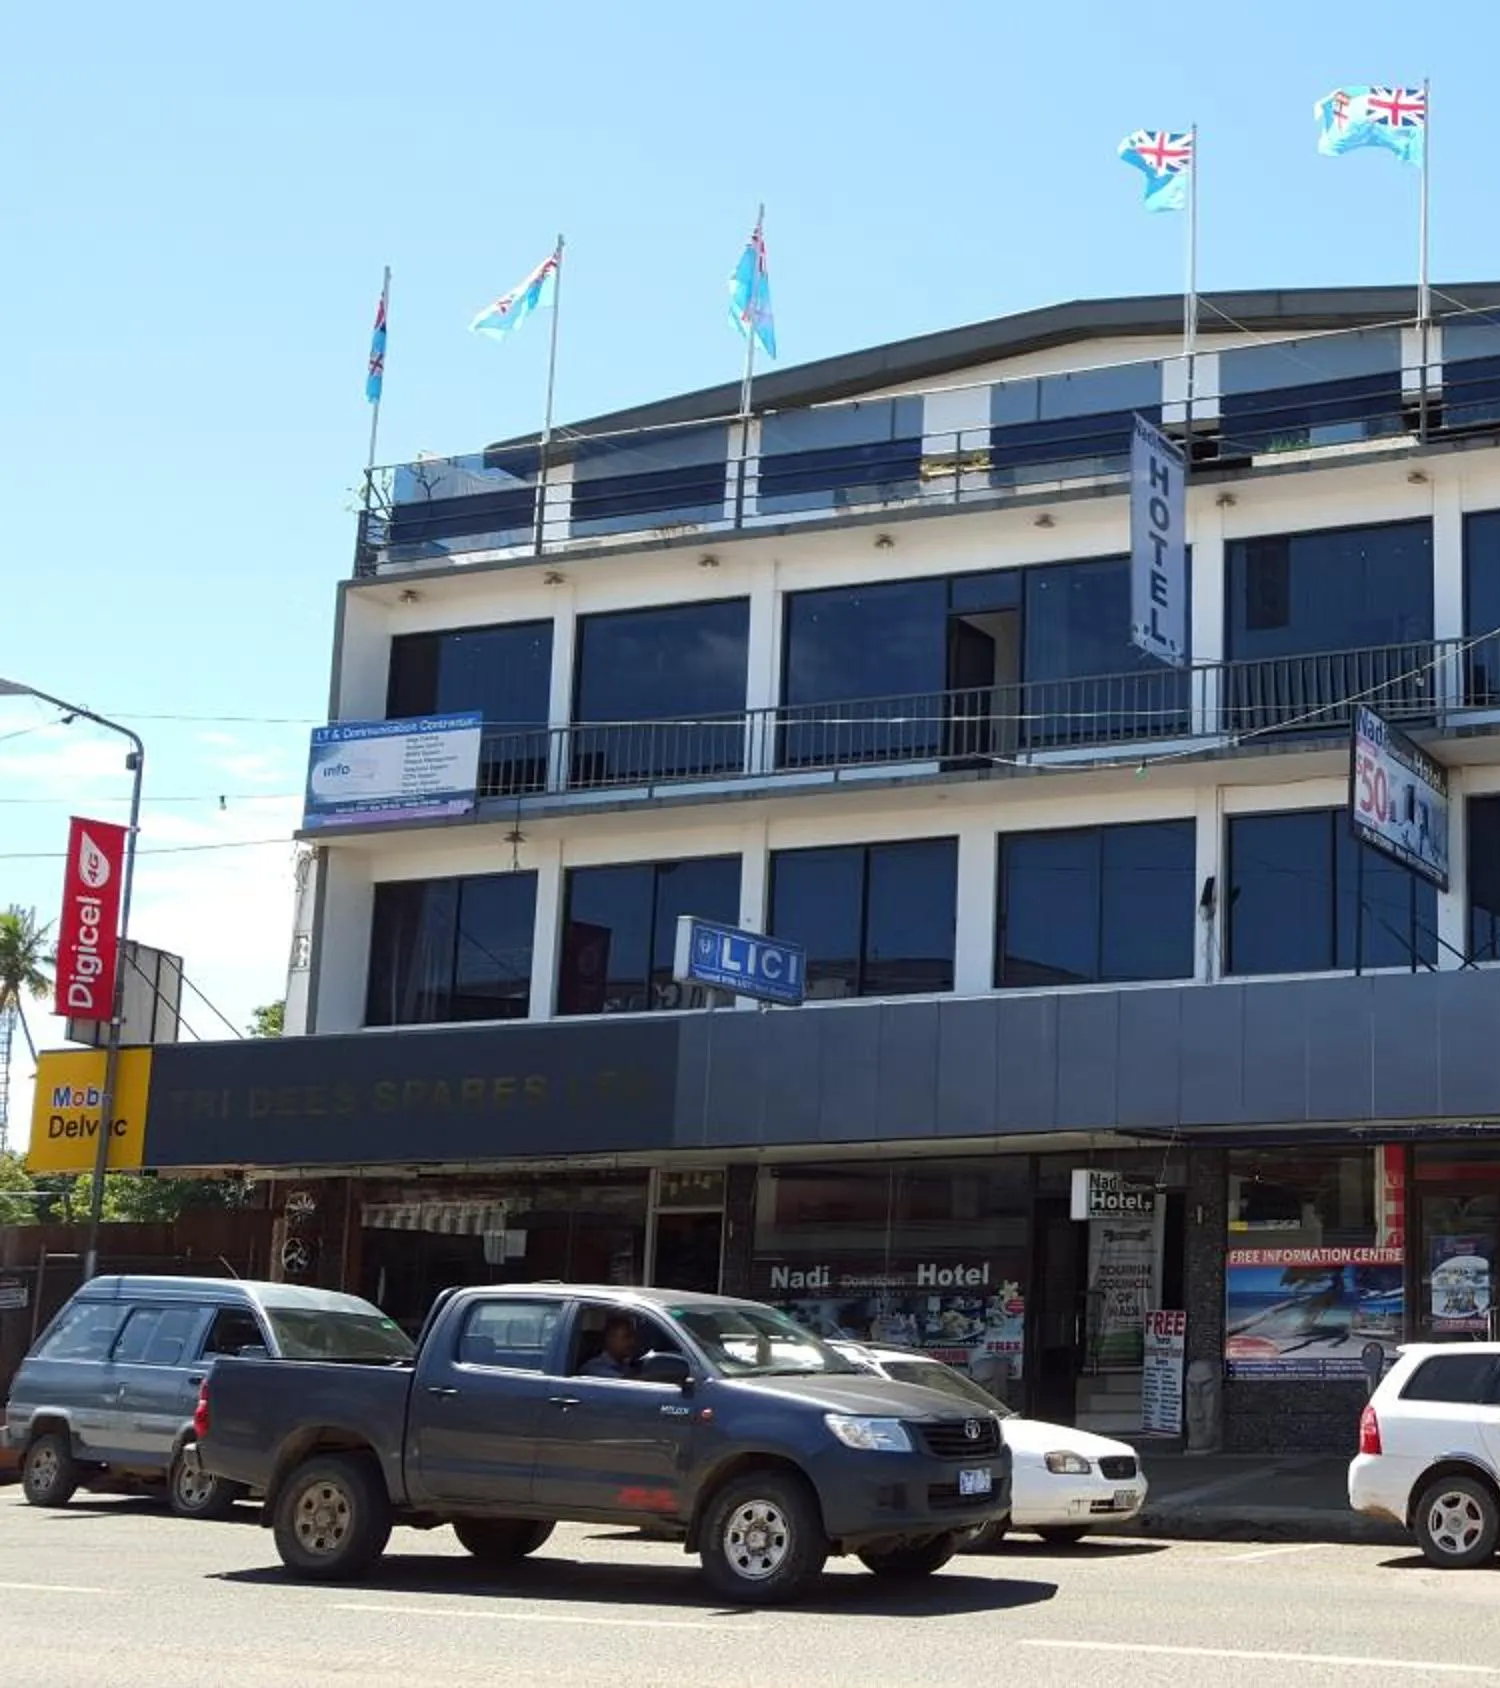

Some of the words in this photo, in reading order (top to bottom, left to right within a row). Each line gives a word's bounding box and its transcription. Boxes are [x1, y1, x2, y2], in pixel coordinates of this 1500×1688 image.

[1149, 456, 1170, 646] HOTEL
[86, 853, 99, 884] 4G
[69, 896, 103, 1008] Digicel
[722, 937, 797, 984] LICI
[1091, 1191, 1143, 1209] Hotel
[1230, 1250, 1259, 1264] FREE
[1262, 1248, 1350, 1263] INFORMATION
[1353, 1247, 1403, 1262] CENTRE
[770, 1264, 831, 1289] Nadi
[917, 1262, 990, 1286] Hotel
[1145, 1311, 1184, 1336] FREE
